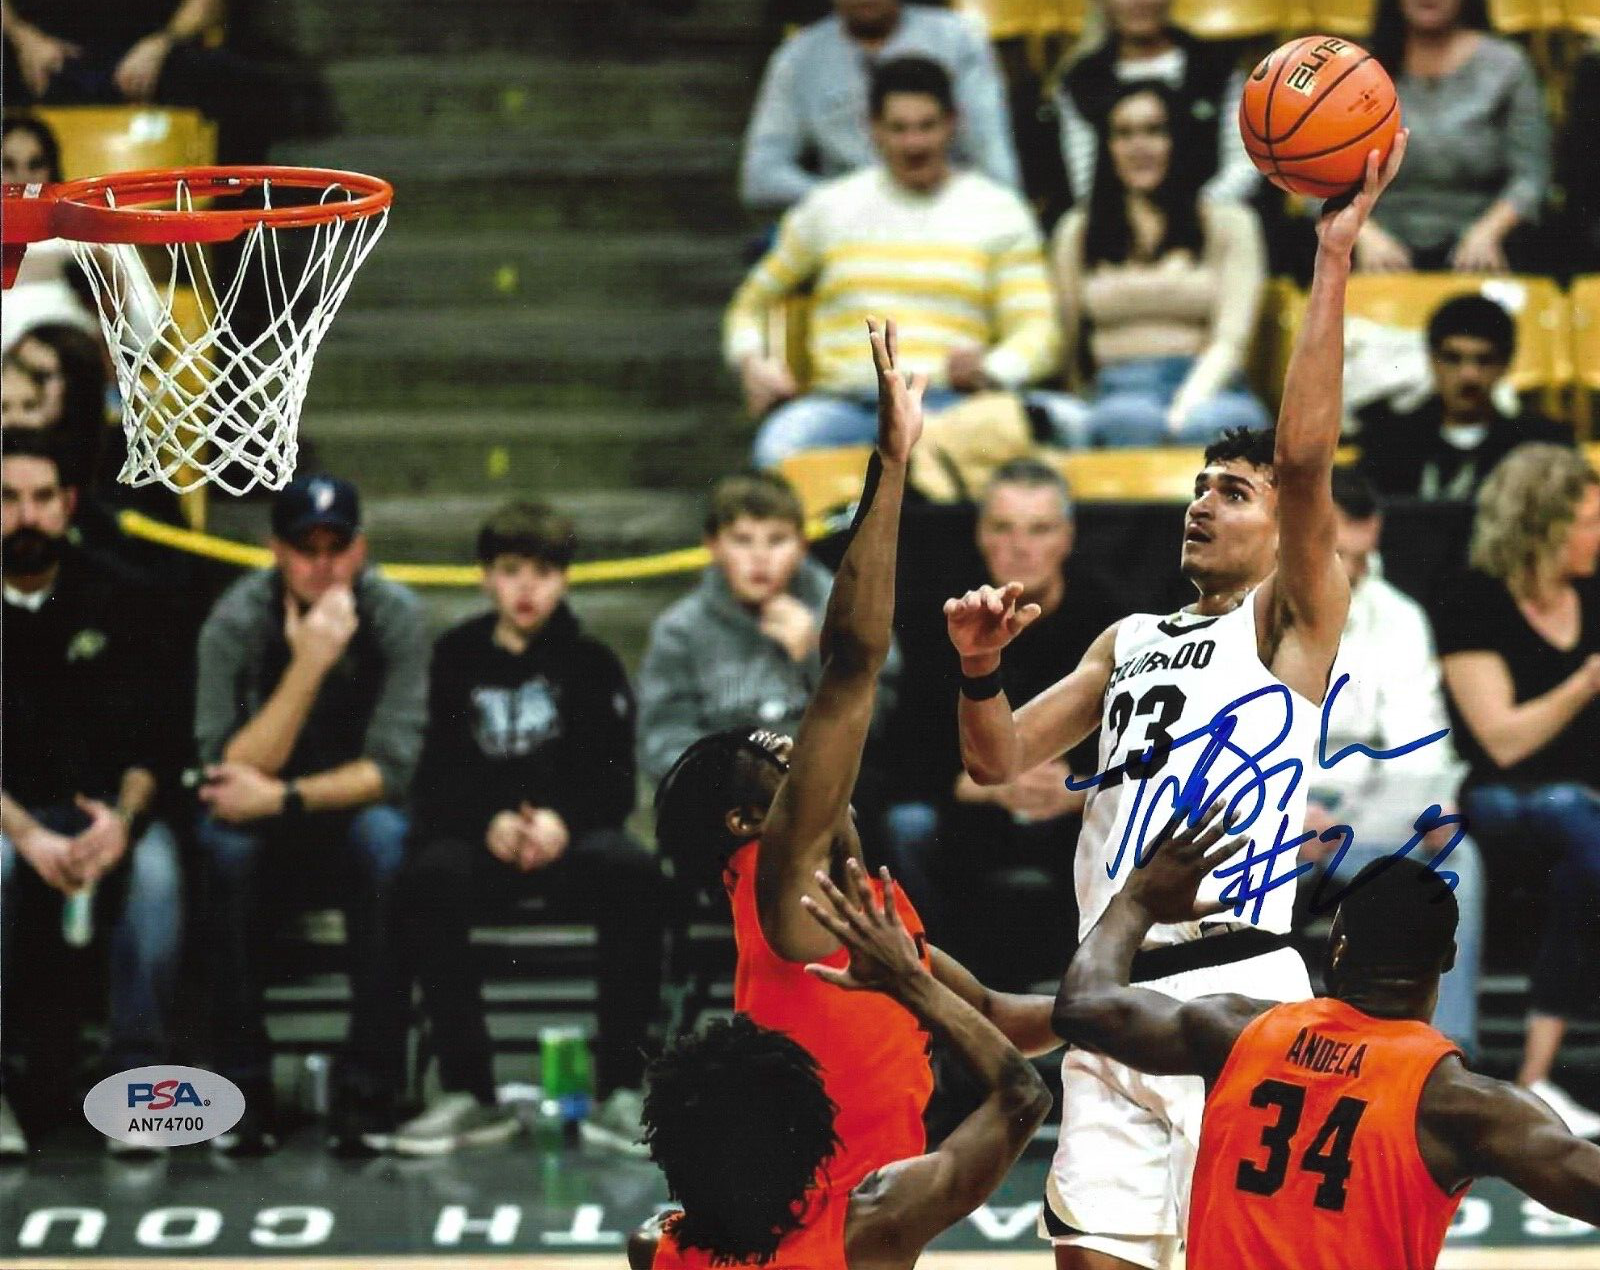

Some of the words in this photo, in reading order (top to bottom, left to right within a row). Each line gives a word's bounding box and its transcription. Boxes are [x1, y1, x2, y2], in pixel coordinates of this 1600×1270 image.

[1097, 684, 1188, 792] 23
[1285, 1026, 1368, 1079] ANDELA
[1235, 1078, 1369, 1213] 34
